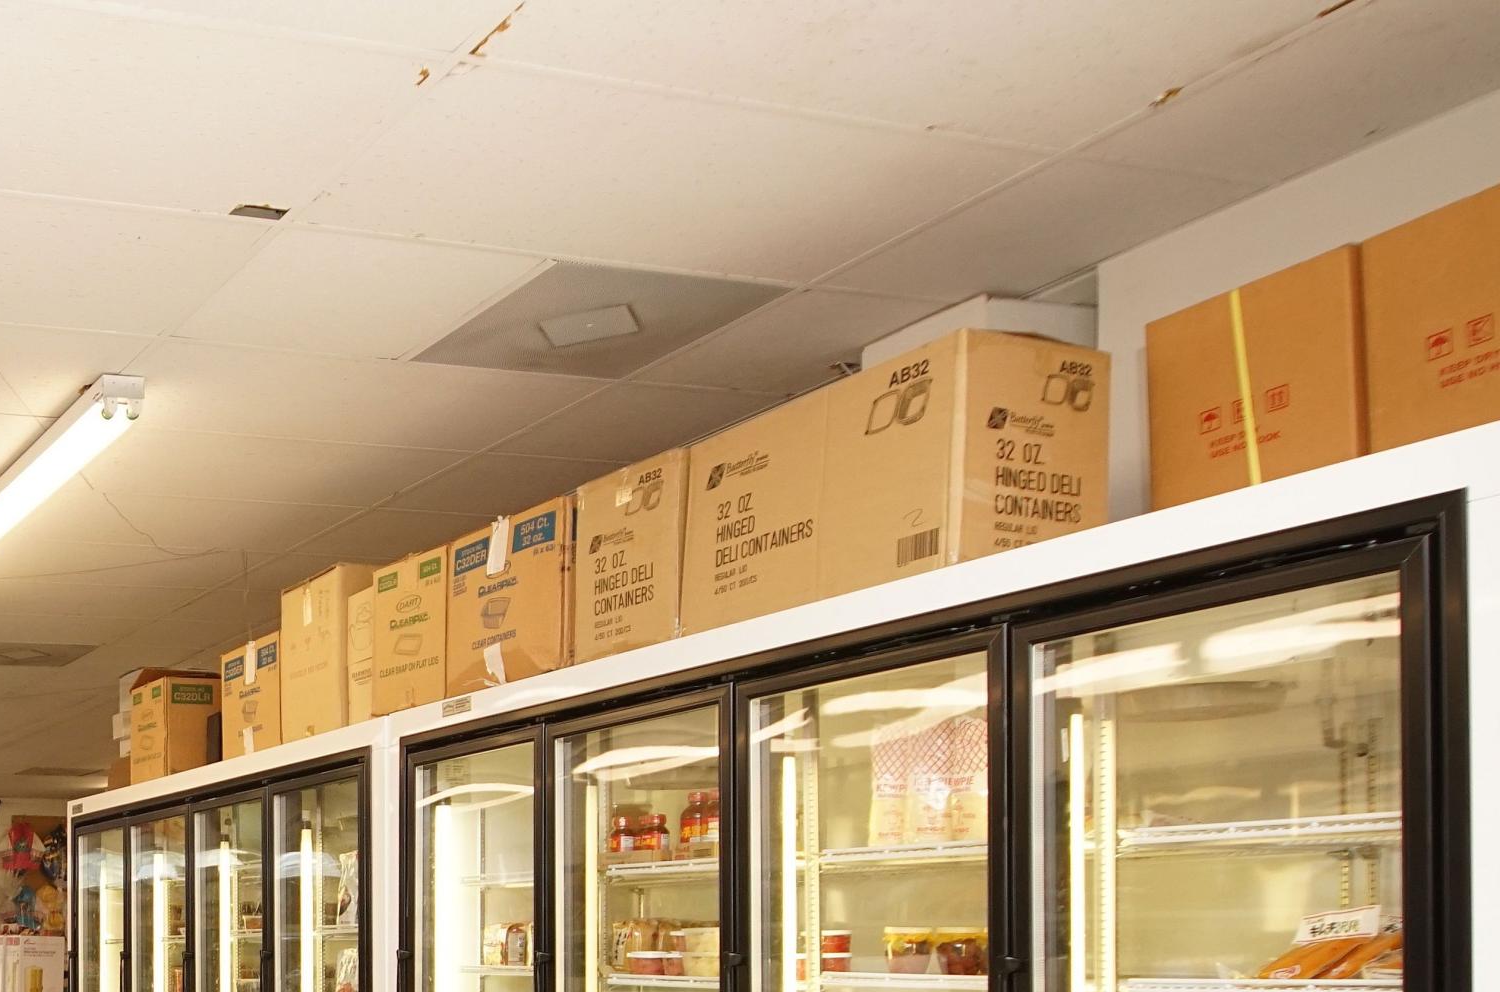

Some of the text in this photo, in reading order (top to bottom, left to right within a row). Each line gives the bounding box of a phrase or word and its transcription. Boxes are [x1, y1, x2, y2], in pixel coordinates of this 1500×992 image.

[889, 359, 930, 388] AB32
[1060, 360, 1092, 377] AB32
[996, 438, 1015, 461] 32
[638, 468, 663, 486] AB32
[995, 466, 1082, 497] HINGED DELI
[717, 501, 731, 521] 32
[994, 493, 1082, 524] CONTAINERS
[715, 518, 813, 568] DELI CONTAINERS
[716, 515, 755, 543] HINGED
[595, 556, 607, 575] 32
[595, 561, 654, 596] HINGED DELI
[399, 597, 419, 611] DART
[595, 584, 654, 616] CONTAINERS
